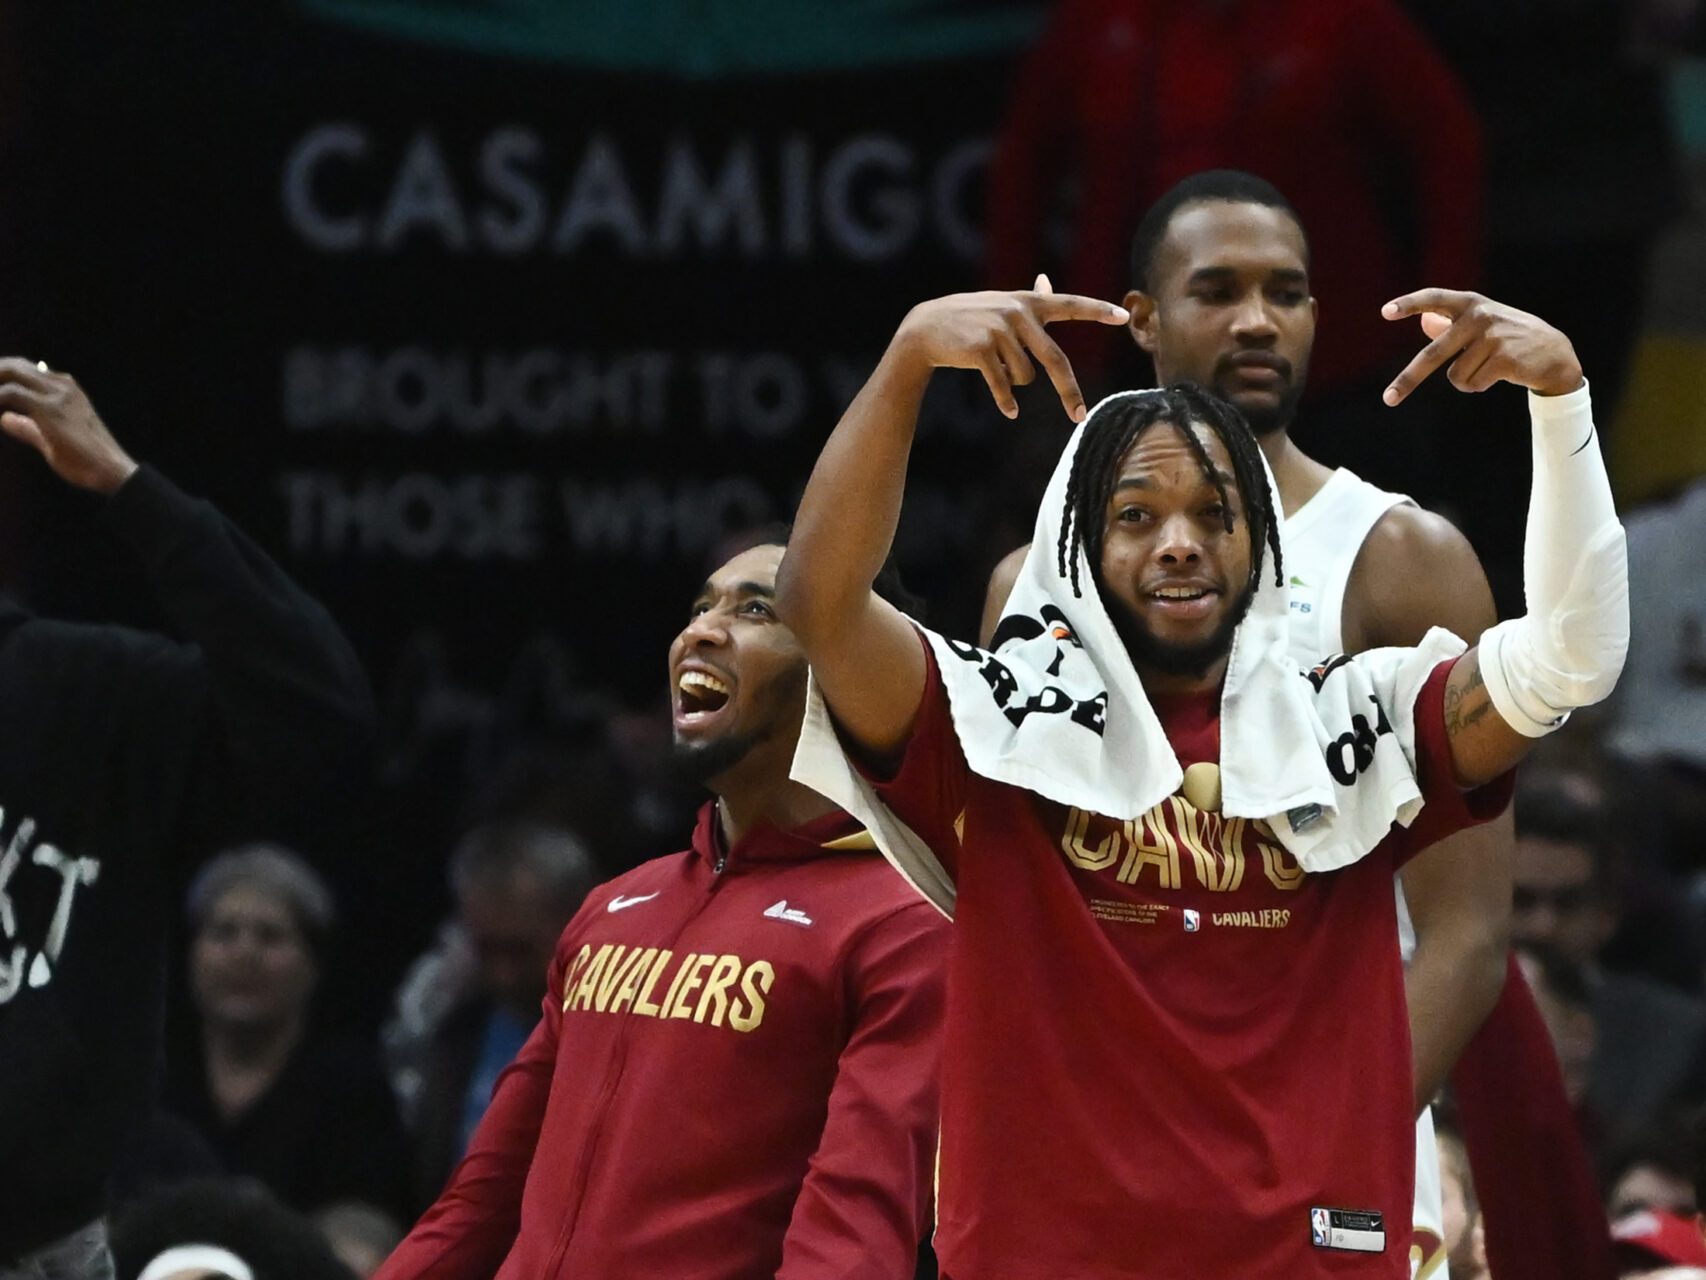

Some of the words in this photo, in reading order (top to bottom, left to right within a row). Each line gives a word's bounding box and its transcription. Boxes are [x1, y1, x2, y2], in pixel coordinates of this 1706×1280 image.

[284, 342, 674, 436] BROUGHT
[693, 349, 808, 440] TO
[282, 471, 538, 562] THOSE
[1212, 909, 1291, 929] CAVALIERS
[563, 944, 775, 1033] CAVALIERS
